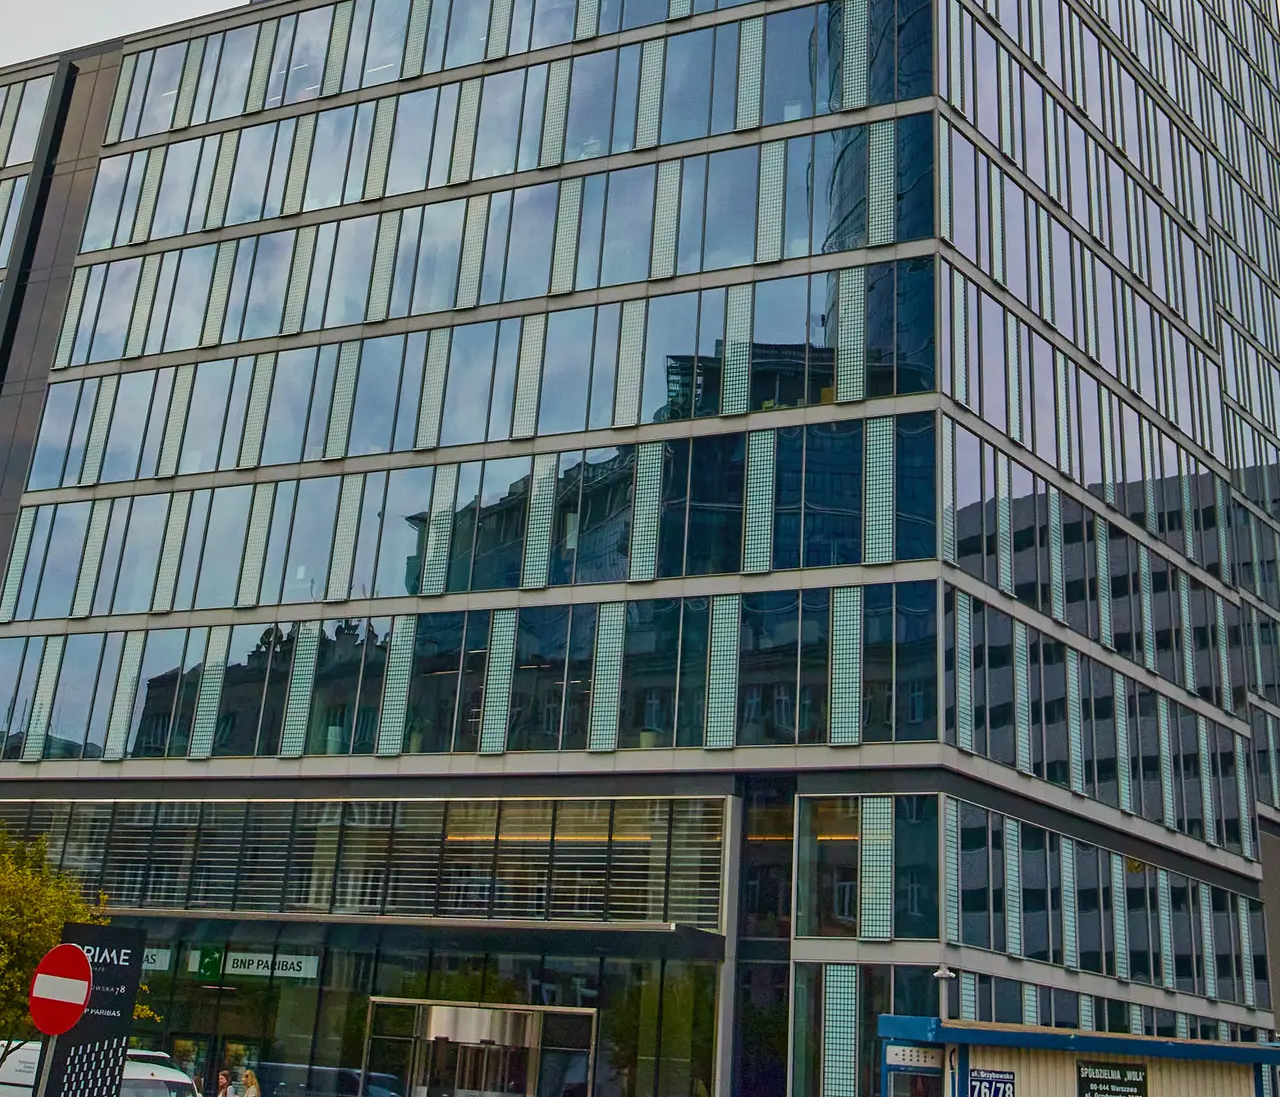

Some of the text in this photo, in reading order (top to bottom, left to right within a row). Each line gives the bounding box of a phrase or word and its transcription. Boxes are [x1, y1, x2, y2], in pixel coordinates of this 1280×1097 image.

[84, 946, 131, 965] RIME
[231, 958, 255, 970] BNP
[90, 1008, 121, 1017] PARIBAS
[971, 1081, 1014, 1097] 76/78
